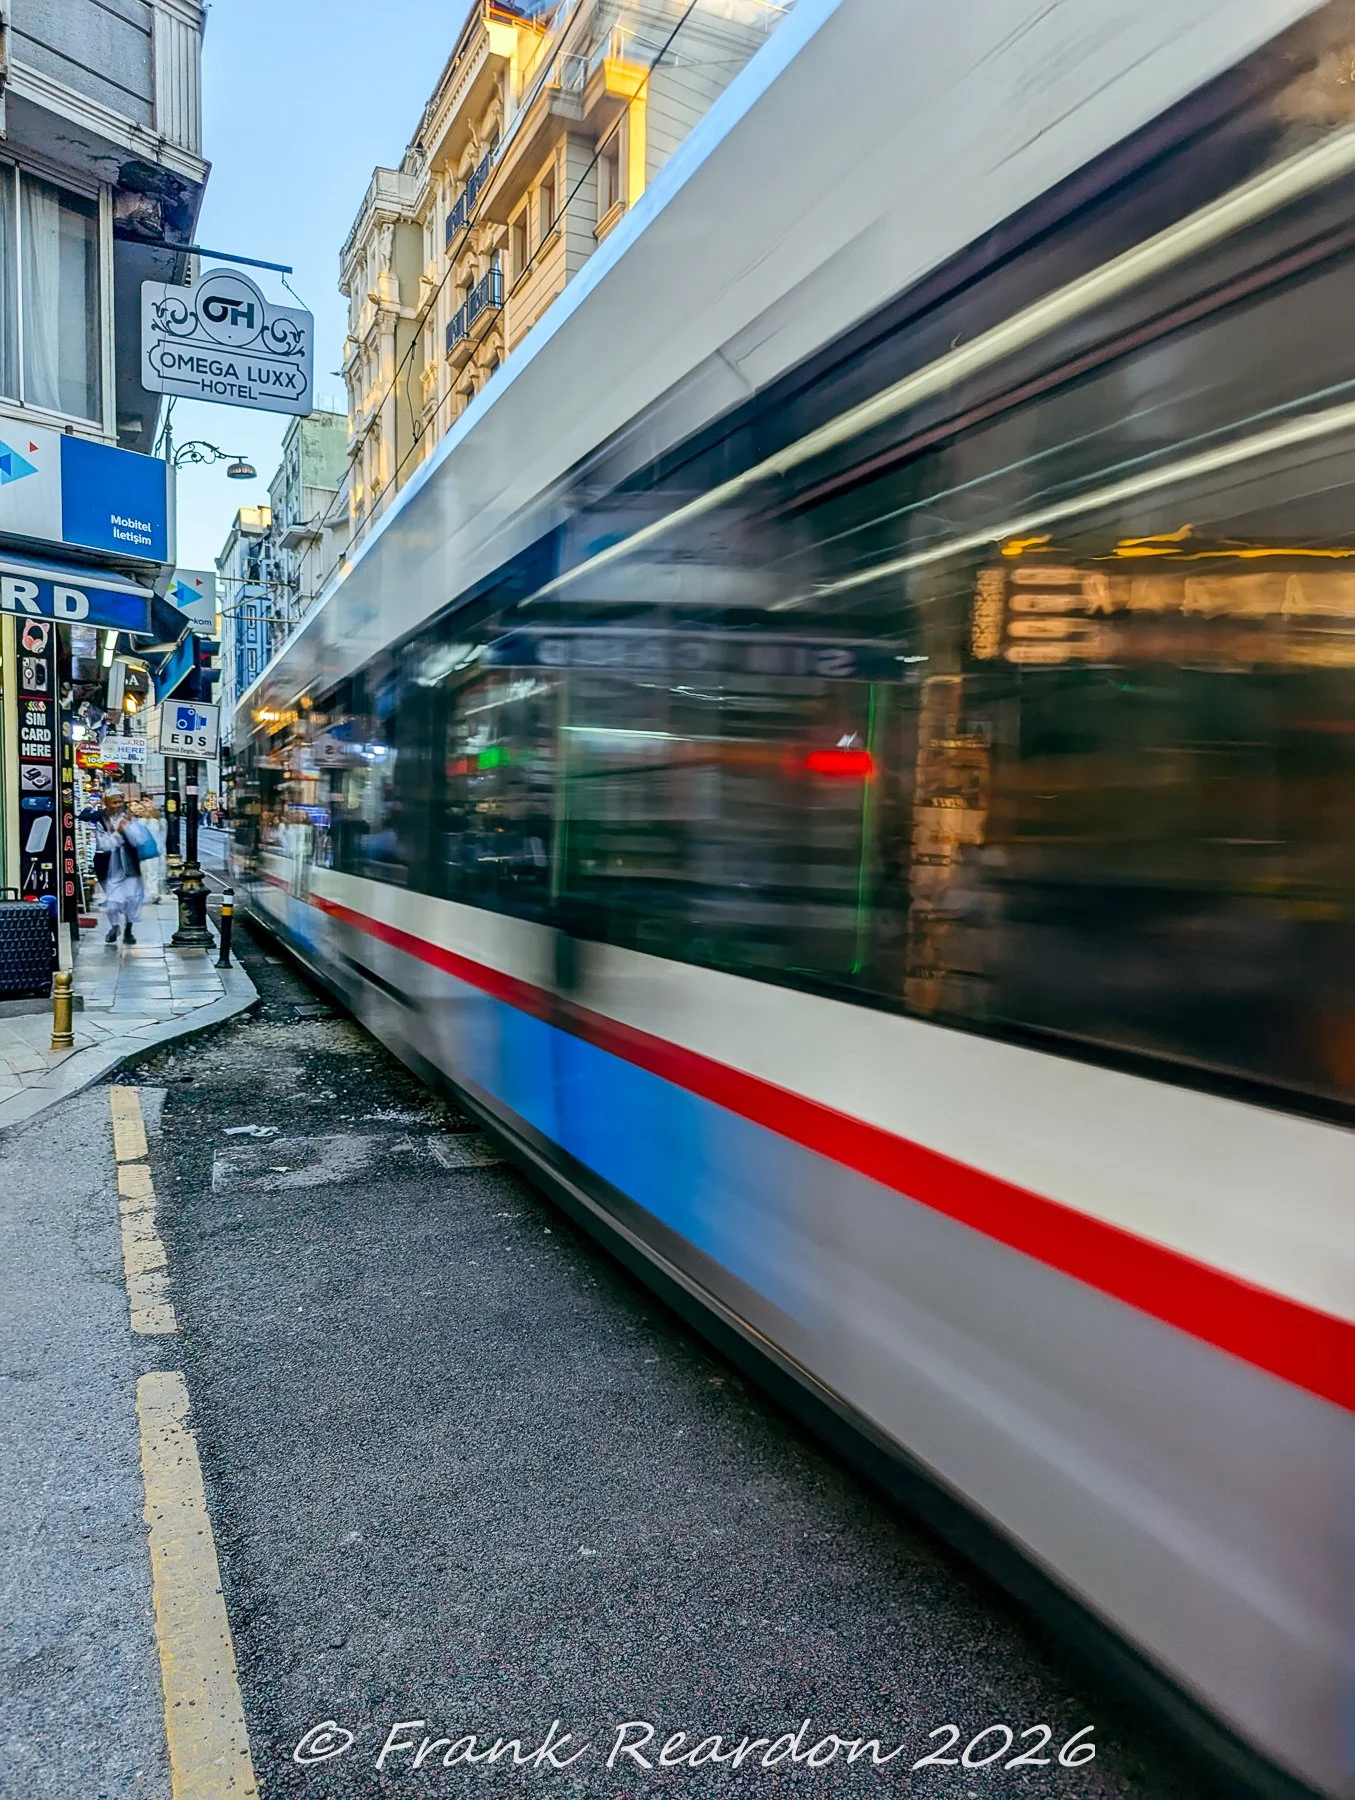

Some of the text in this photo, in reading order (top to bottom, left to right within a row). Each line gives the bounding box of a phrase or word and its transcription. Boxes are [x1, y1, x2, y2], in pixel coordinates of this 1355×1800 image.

[160, 352, 297, 389] OMEGA LUXX
[201, 379, 258, 400] HOTEL
[111, 514, 152, 533] Mobitel
[113, 528, 152, 546] İletişim
[190, 617, 212, 626] kom
[25, 712, 46, 726] SIM
[21, 727, 52, 742] CARD
[171, 733, 207, 747] EDS
[21, 743, 52, 758] HERE
[64, 812, 75, 896] CARD
